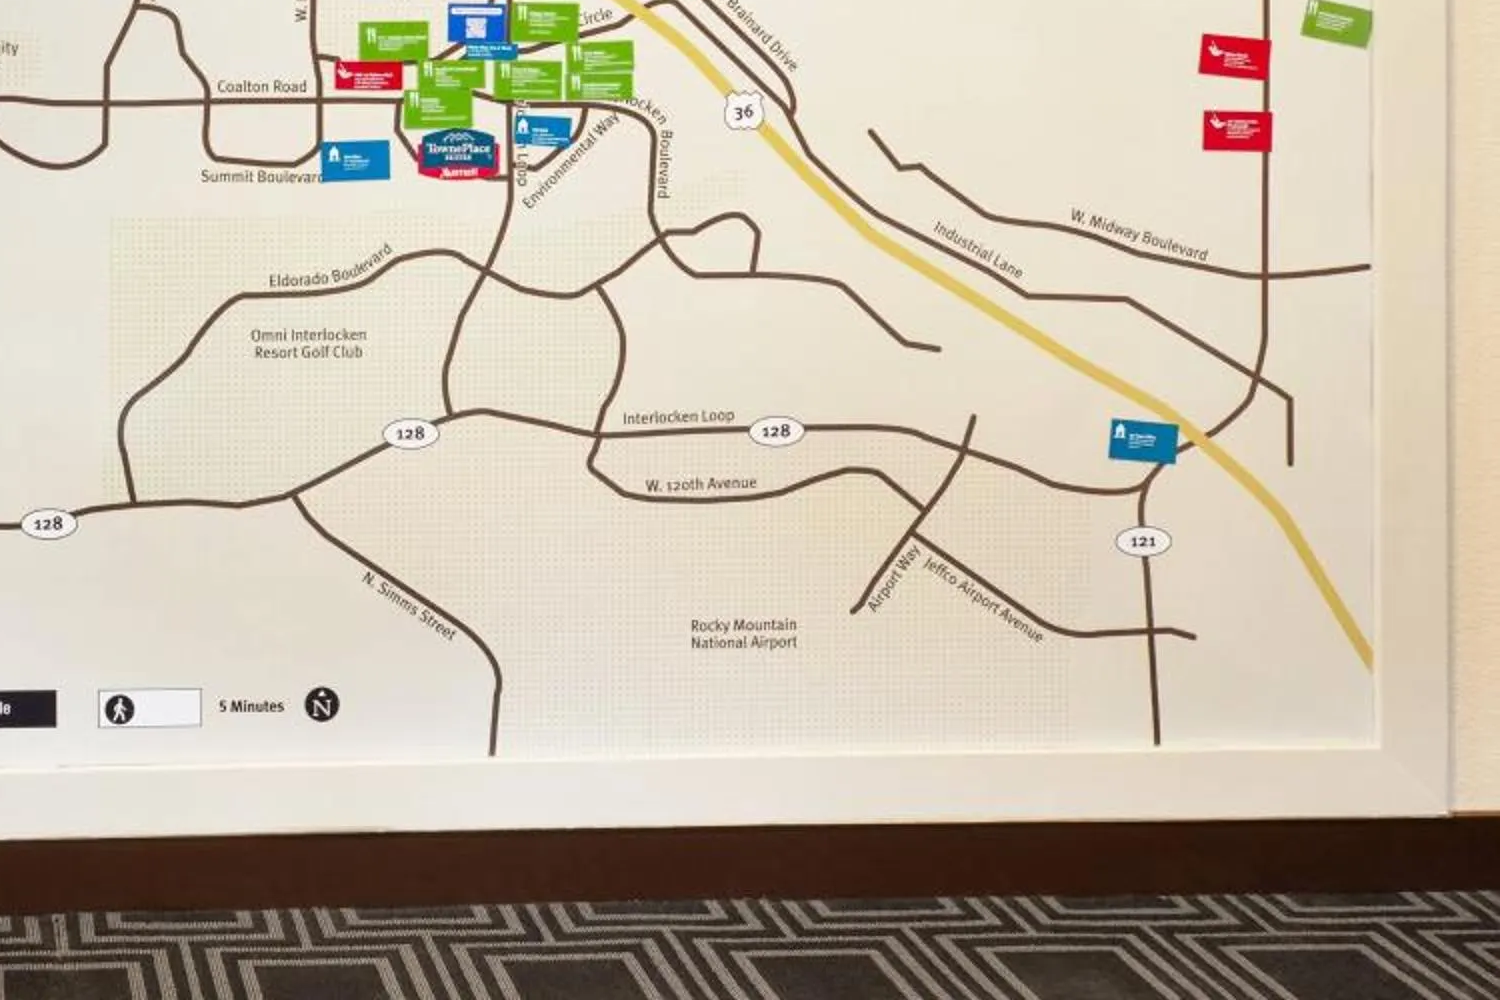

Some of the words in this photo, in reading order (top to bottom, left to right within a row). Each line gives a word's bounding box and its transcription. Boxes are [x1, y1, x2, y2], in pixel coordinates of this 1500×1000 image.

[294, 4, 308, 23] W.
[769, 39, 798, 72] Drive
[217, 80, 273, 94] Coalton
[277, 80, 308, 94] Road
[733, 104, 755, 121] 36
[521, 132, 597, 210] Environmental
[594, 112, 621, 137] Way
[657, 129, 674, 200] Boulevard
[201, 169, 253, 183] Summit
[514, 153, 529, 187] Loop
[1071, 207, 1087, 225] W.
[1089, 213, 1141, 243] Midway
[1141, 230, 1209, 262] Boulevard
[934, 220, 994, 264] Industrial
[991, 252, 1024, 279] Lane
[269, 272, 329, 289] Eldorado
[331, 243, 393, 283] Boulevard
[251, 329, 288, 342] Omni
[291, 329, 368, 342] Interlocken
[254, 346, 298, 359] Resort
[301, 345, 331, 359] Golf
[333, 345, 364, 359] Club
[623, 411, 699, 425] Interlocken
[701, 410, 736, 424] Loop
[396, 426, 425, 440] 128
[761, 424, 791, 437] 128
[645, 479, 662, 492] W.
[667, 478, 704, 492] 120th
[707, 478, 757, 489] Avenue
[34, 517, 63, 531] 128
[1130, 536, 1157, 548] 121
[867, 574, 902, 613] Airport
[898, 543, 922, 577] Way
[362, 570, 378, 586] N.
[377, 581, 418, 614] Simms
[414, 604, 457, 641] Street
[923, 556, 958, 586] Jeffco
[957, 579, 1002, 616] Airport
[998, 606, 1044, 644] Avenue
[691, 619, 731, 635] Rocky
[733, 617, 797, 632] Mountain
[691, 635, 749, 650] National
[752, 635, 797, 652] Airport
[219, 700, 228, 713] 5
[231, 699, 285, 713] Minutes
[310, 699, 332, 719] N
